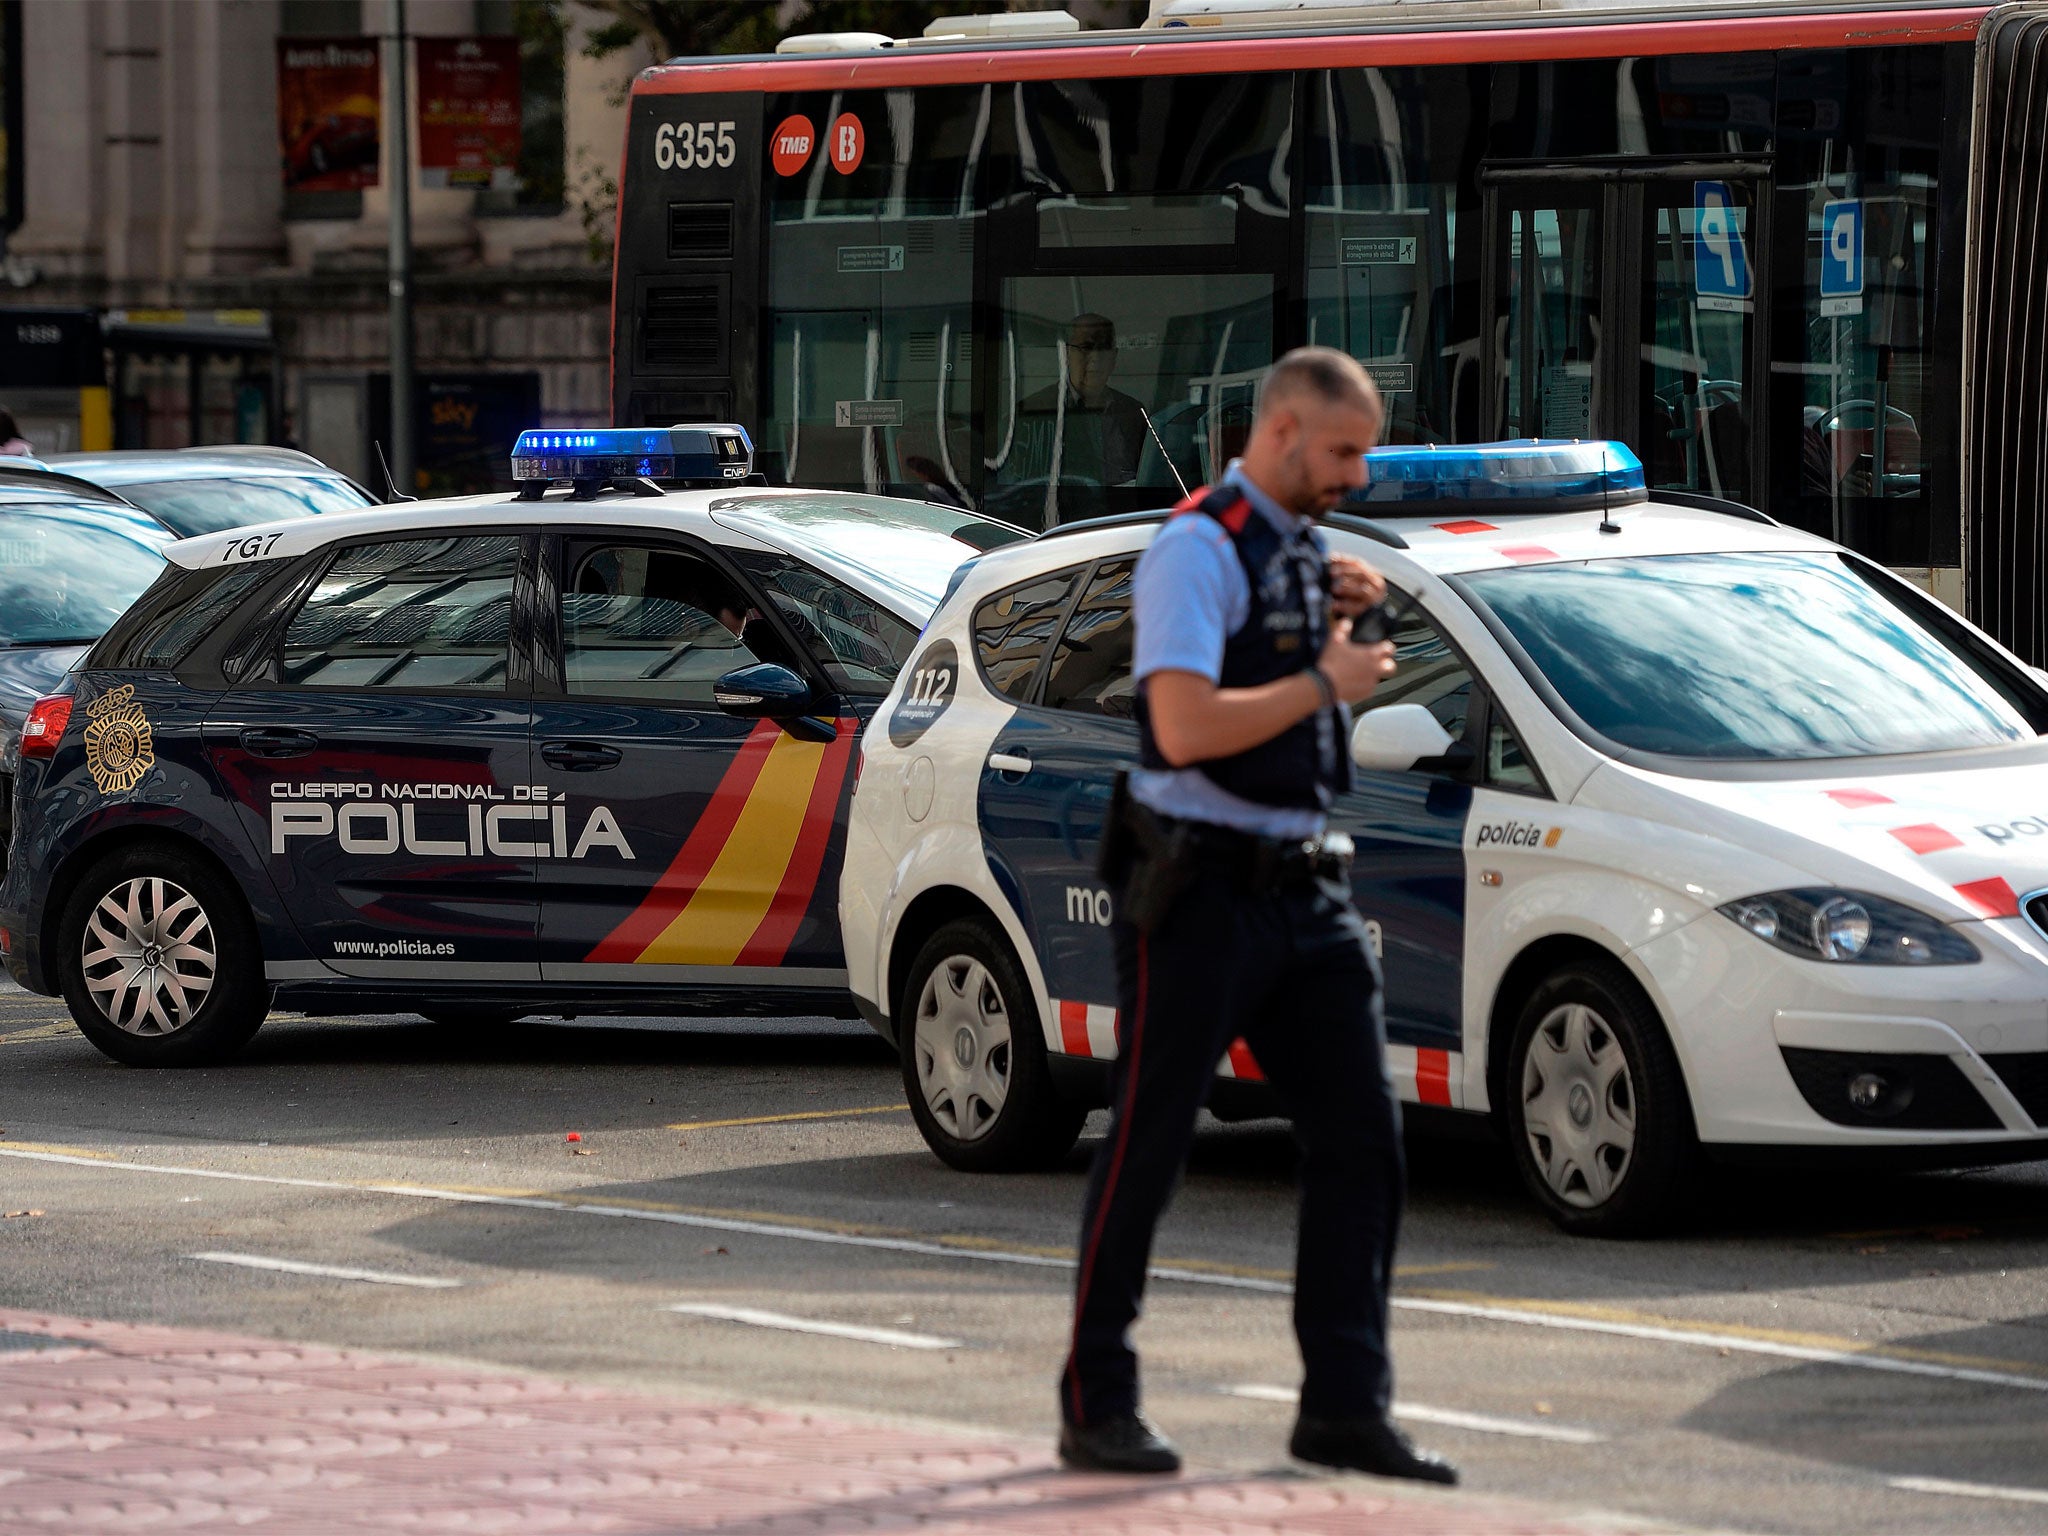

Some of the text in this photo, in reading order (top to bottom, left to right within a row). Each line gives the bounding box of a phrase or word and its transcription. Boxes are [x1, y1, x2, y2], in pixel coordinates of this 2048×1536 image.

[654, 121, 737, 171] 6355
[779, 136, 810, 155] TMB
[222, 532, 284, 563] 7G7
[906, 668, 951, 707] 112
[270, 782, 549, 801] CUERPO NACIONAL DE
[270, 792, 636, 860] POLICÍA
[333, 939, 456, 957] www.policia.es
